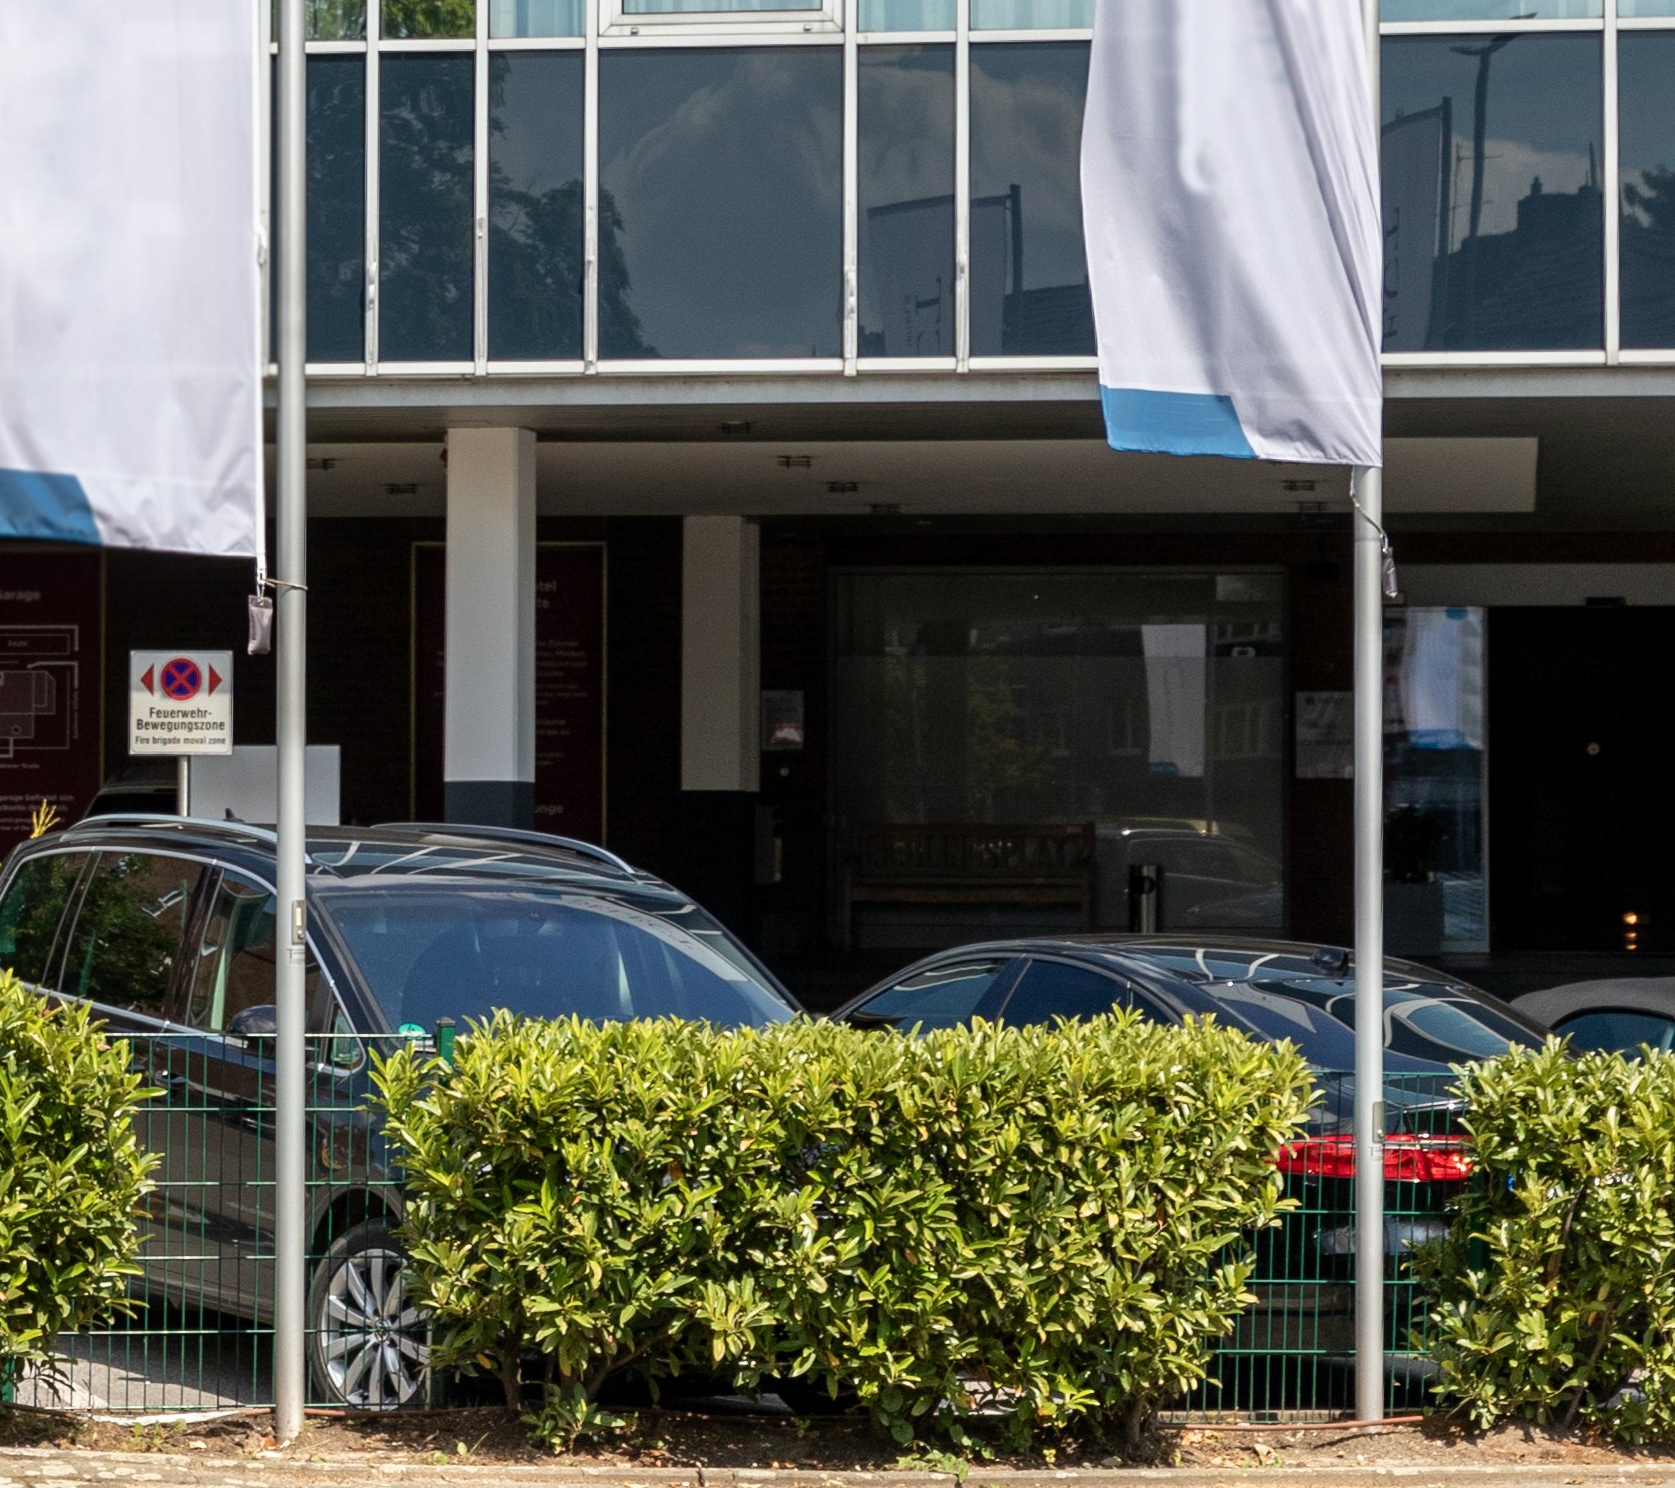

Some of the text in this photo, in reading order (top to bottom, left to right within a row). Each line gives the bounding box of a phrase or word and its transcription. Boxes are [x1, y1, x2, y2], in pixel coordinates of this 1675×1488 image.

[149, 707, 213, 719] Feuerwehr-
[136, 718, 225, 733] Bewegungszone
[135, 735, 150, 745] Fire
[152, 735, 181, 746] brigade
[208, 736, 227, 745] zone
